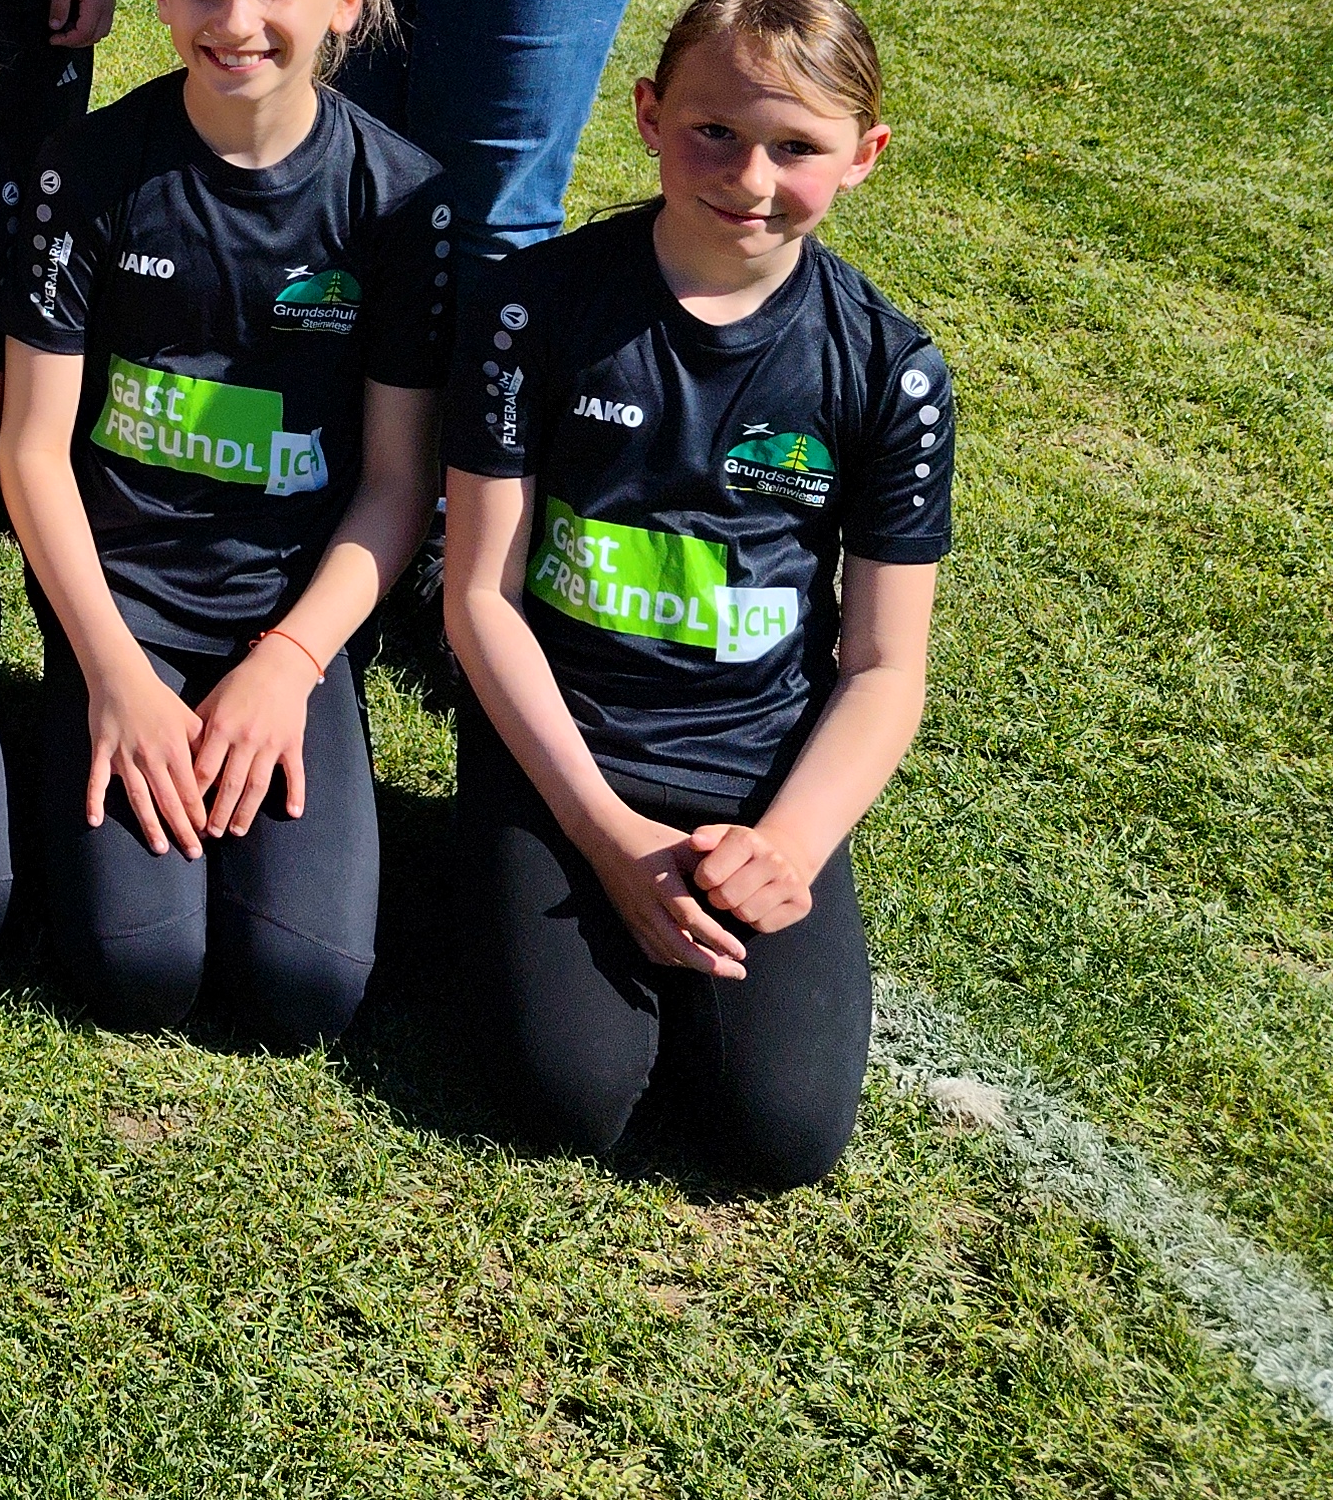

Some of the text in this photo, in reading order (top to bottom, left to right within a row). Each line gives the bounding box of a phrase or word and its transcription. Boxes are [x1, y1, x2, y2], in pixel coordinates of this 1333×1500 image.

[43, 237, 63, 318] FLYERALARM
[118, 251, 175, 279] JAKO
[111, 371, 185, 422] Gast
[573, 394, 644, 428] JAKO
[724, 459, 830, 492] Grundschule
[551, 516, 620, 574] Gast
